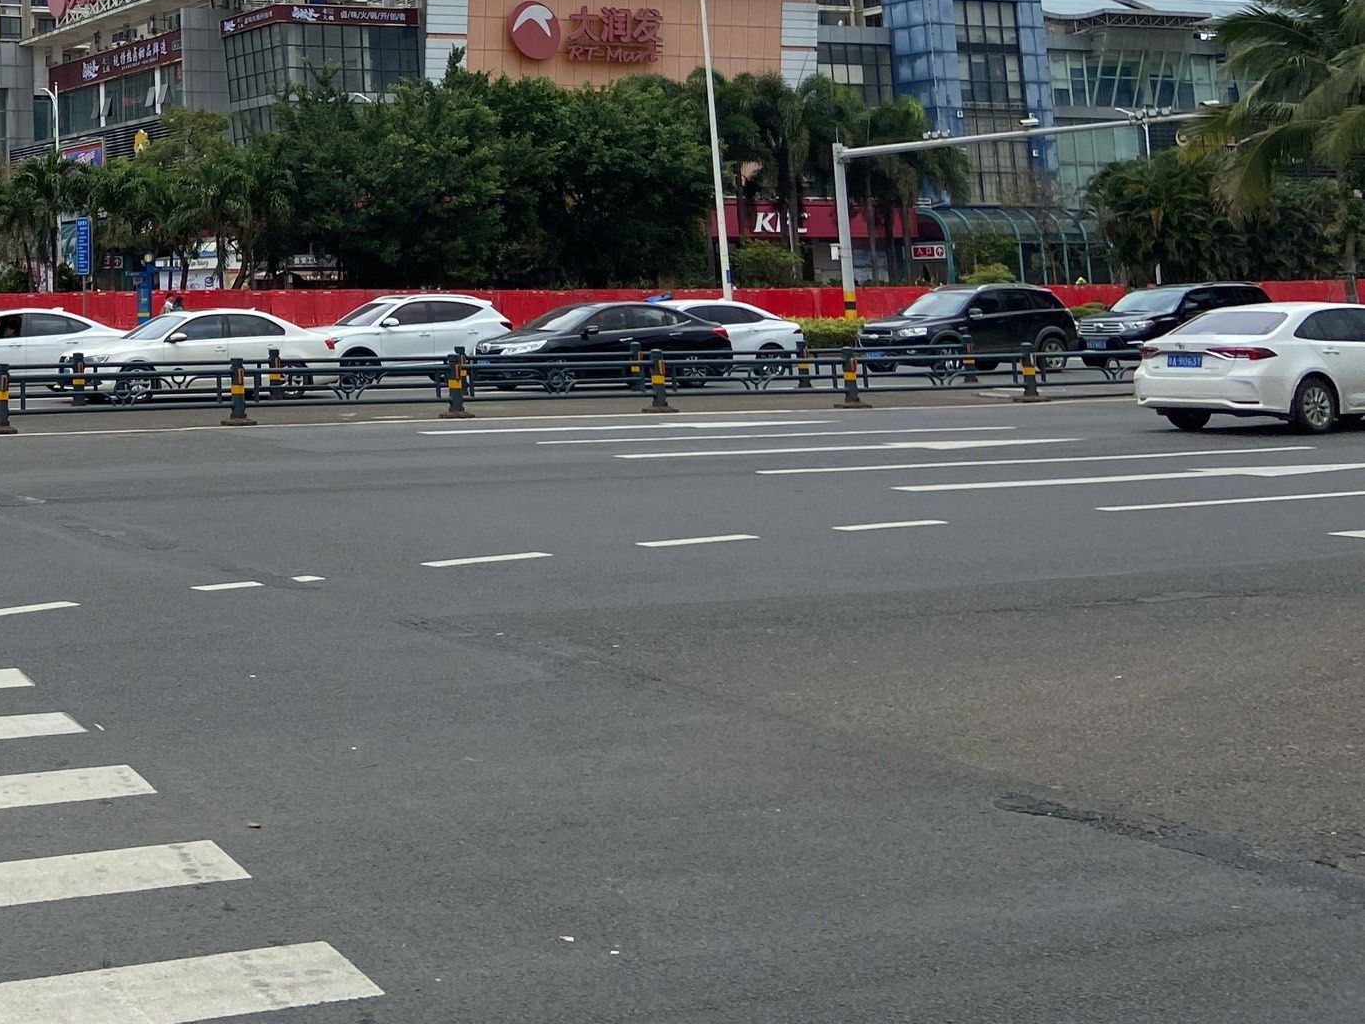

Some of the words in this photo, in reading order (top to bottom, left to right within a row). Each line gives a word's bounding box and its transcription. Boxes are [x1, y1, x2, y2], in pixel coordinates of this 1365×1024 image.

[567, 5, 663, 44] 大润发
[567, 45, 660, 64] RT-Mart
